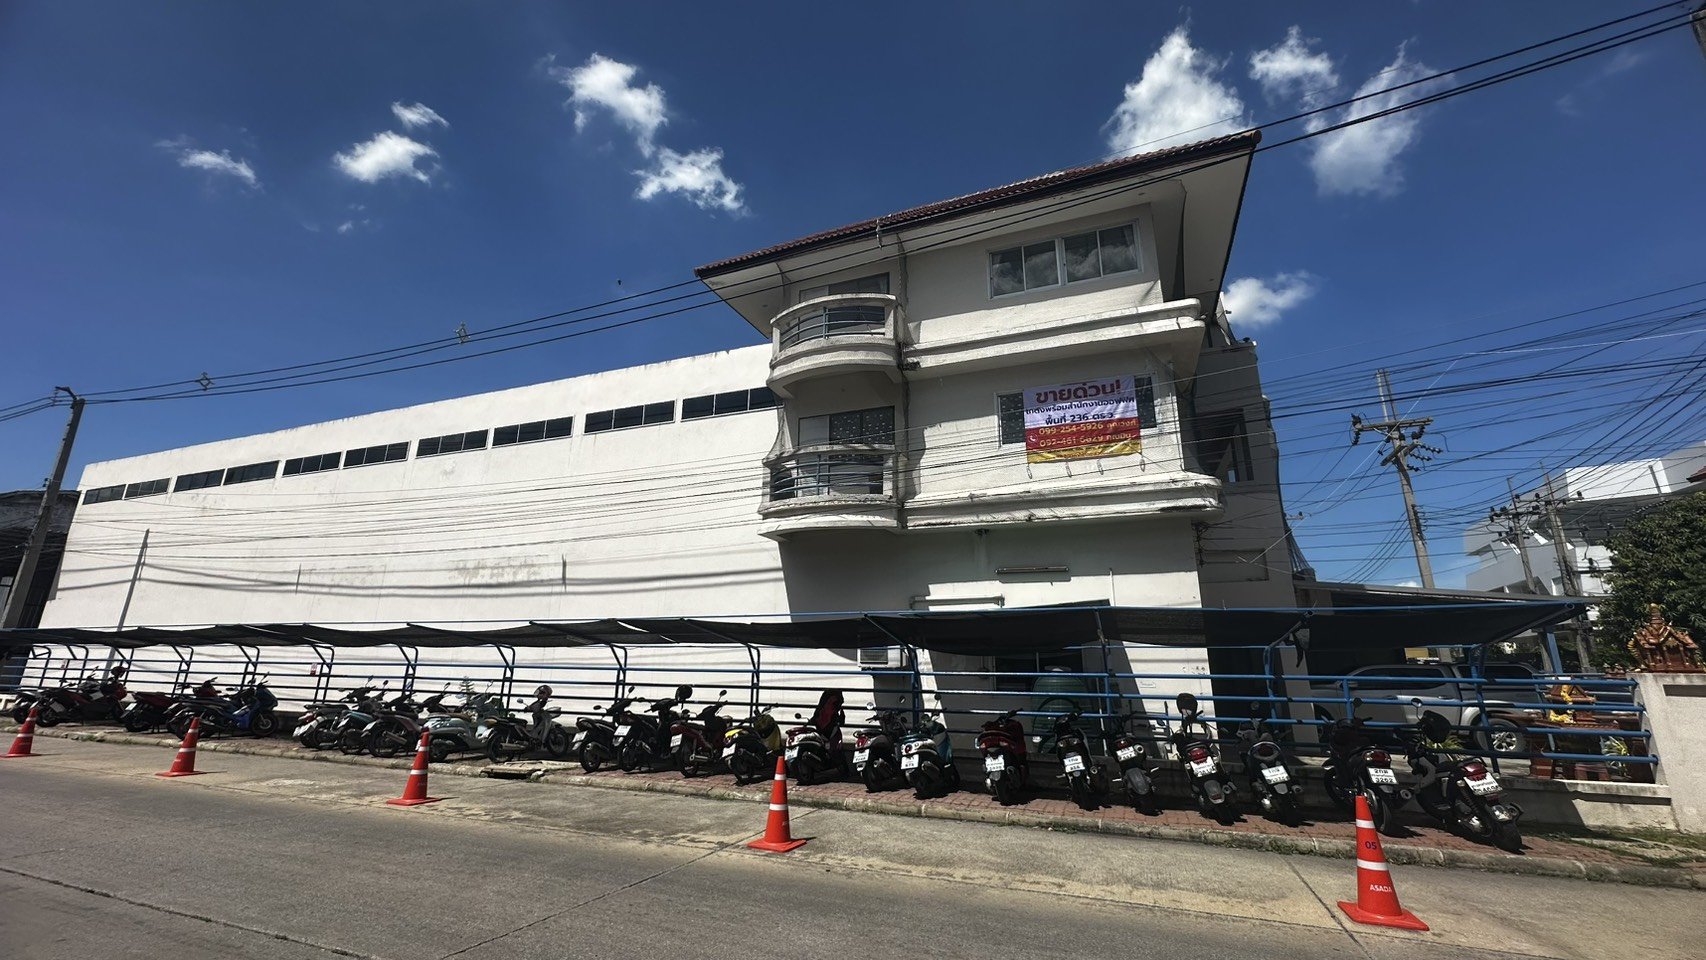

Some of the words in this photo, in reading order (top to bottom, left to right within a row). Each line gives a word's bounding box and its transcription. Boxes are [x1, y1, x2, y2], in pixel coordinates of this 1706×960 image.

[1036, 379, 1121, 404] ขายด่วน!
[1070, 413, 1089, 423] 236
[1365, 841, 1377, 850] 05
[1369, 884, 1392, 893] ASADA
